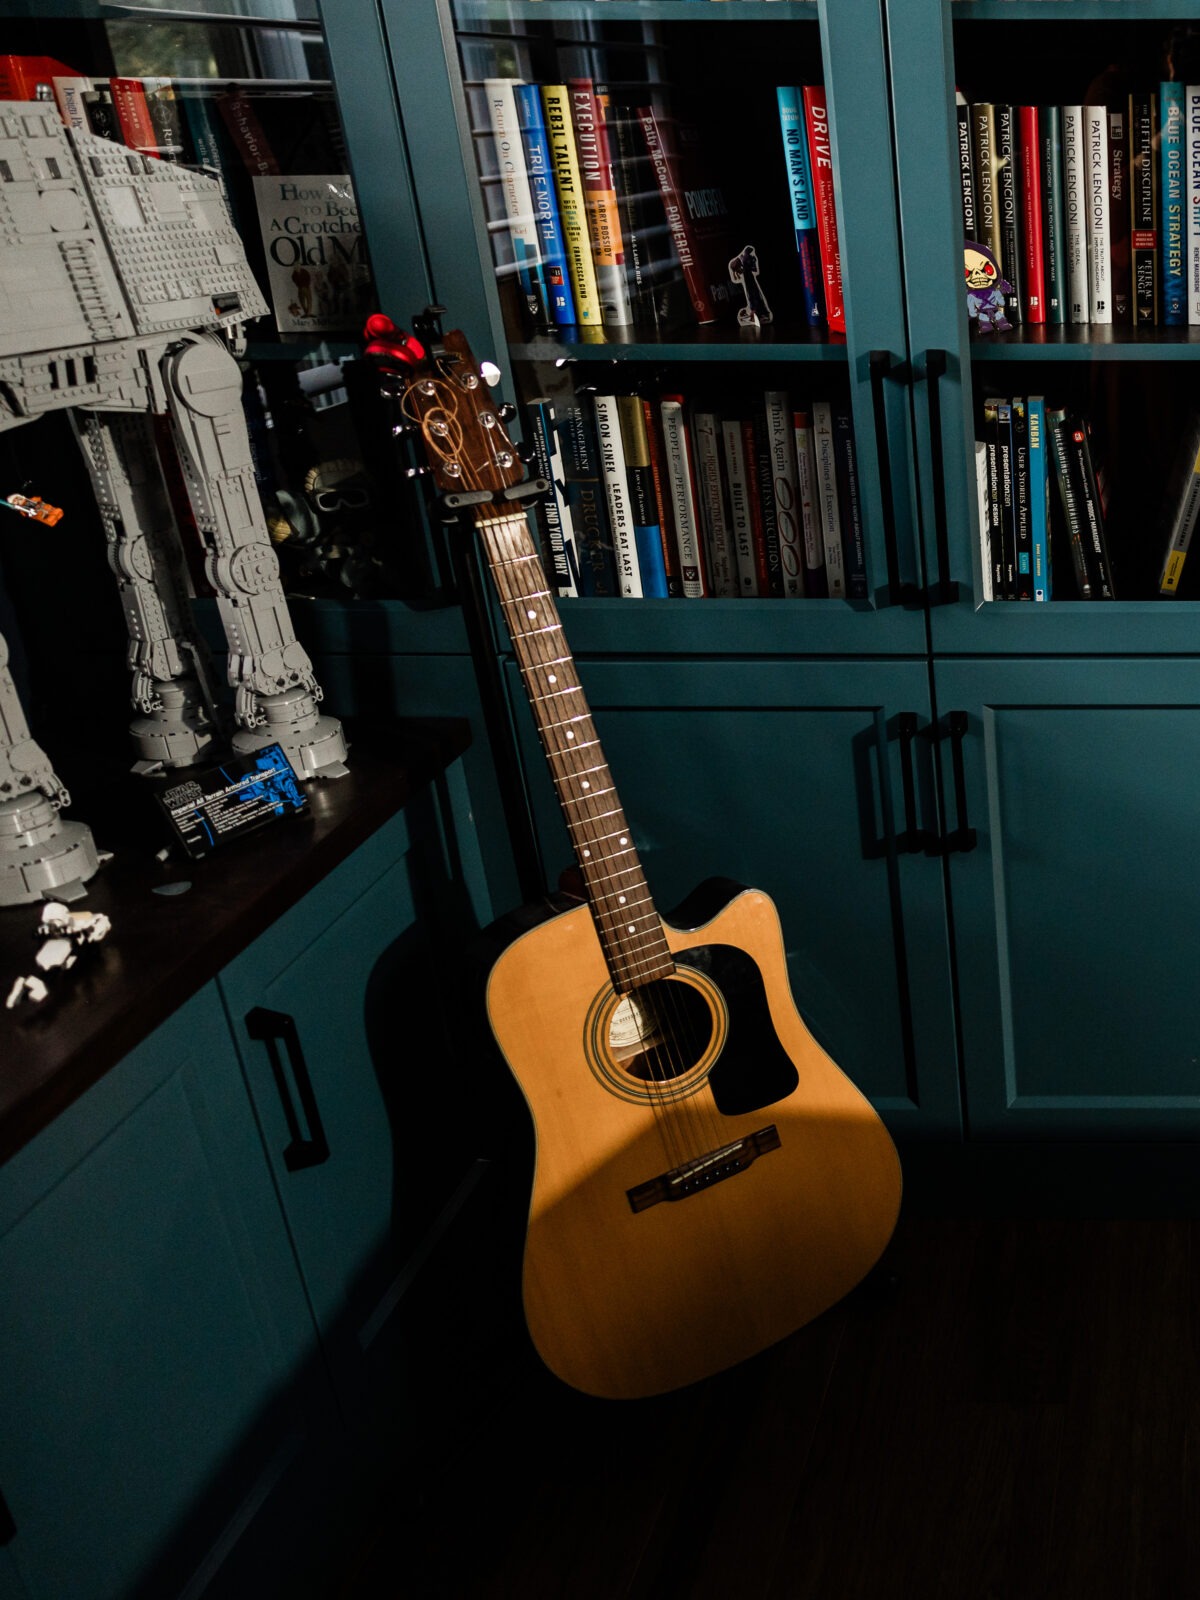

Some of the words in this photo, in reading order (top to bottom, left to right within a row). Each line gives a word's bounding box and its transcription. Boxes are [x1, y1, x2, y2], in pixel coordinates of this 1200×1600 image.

[573, 92, 600, 181] EXECUTION
[785, 128, 798, 144] NO
[979, 116, 990, 167] PATRICK
[1000, 113, 1010, 162] PATRICK
[1066, 115, 1076, 164] PATRICK
[1091, 120, 1101, 169] PATRICK
[1140, 118, 1150, 154] FIFTH
[1166, 106, 1179, 144] BLUE
[528, 146, 545, 184] TRUE
[641, 116, 658, 147] Patty
[652, 149, 670, 193] McCord
[789, 148, 804, 186] MAN'S
[958, 121, 970, 176] PATRICK
[555, 144, 574, 193] TALENT
[1110, 148, 1123, 200] Strategy
[1166, 149, 1181, 198] OCEAN
[279, 184, 322, 200] How
[794, 189, 809, 220] LAND
[961, 178, 974, 231] LENCIONI
[982, 170, 992, 229] LENCIONI
[1003, 166, 1014, 224] LENCIONI
[1068, 167, 1078, 225] LENCIONI
[1093, 174, 1103, 229] LENCIONI
[1140, 158, 1152, 222] DISCIPLINE
[536, 191, 555, 239] NORTH
[270, 237, 328, 266] Old
[667, 206, 690, 269] POWERFUL
[1167, 204, 1183, 276] STRATEGY
[1136, 264, 1145, 294] SENGE
[597, 402, 611, 439] SIMON
[698, 426, 713, 437] 7
[769, 400, 785, 435] Think
[1029, 413, 1039, 448] KANBAN
[573, 409, 590, 471] MANAGEMENT
[602, 443, 616, 473] SINEK
[772, 437, 788, 472] Again
[668, 418, 681, 460] PEOPLE
[675, 478, 693, 559] PERFORMANCE
[706, 456, 717, 483] HIGHLY
[999, 445, 1013, 507] presentationzen
[544, 501, 559, 524] FIND
[611, 482, 625, 527] LEADERS
[710, 484, 722, 523] EFFECTIVE
[731, 481, 744, 512] BUILT
[548, 527, 564, 551] YOUR
[580, 488, 605, 573] DRUCKER
[619, 531, 628, 549] EAT
[714, 523, 726, 552] PEOPLE
[736, 515, 745, 529] TO
[737, 532, 749, 558] LAST
[765, 516, 780, 573] EXECUTION
[552, 552, 568, 577] WHY
[622, 552, 632, 577] LAST
